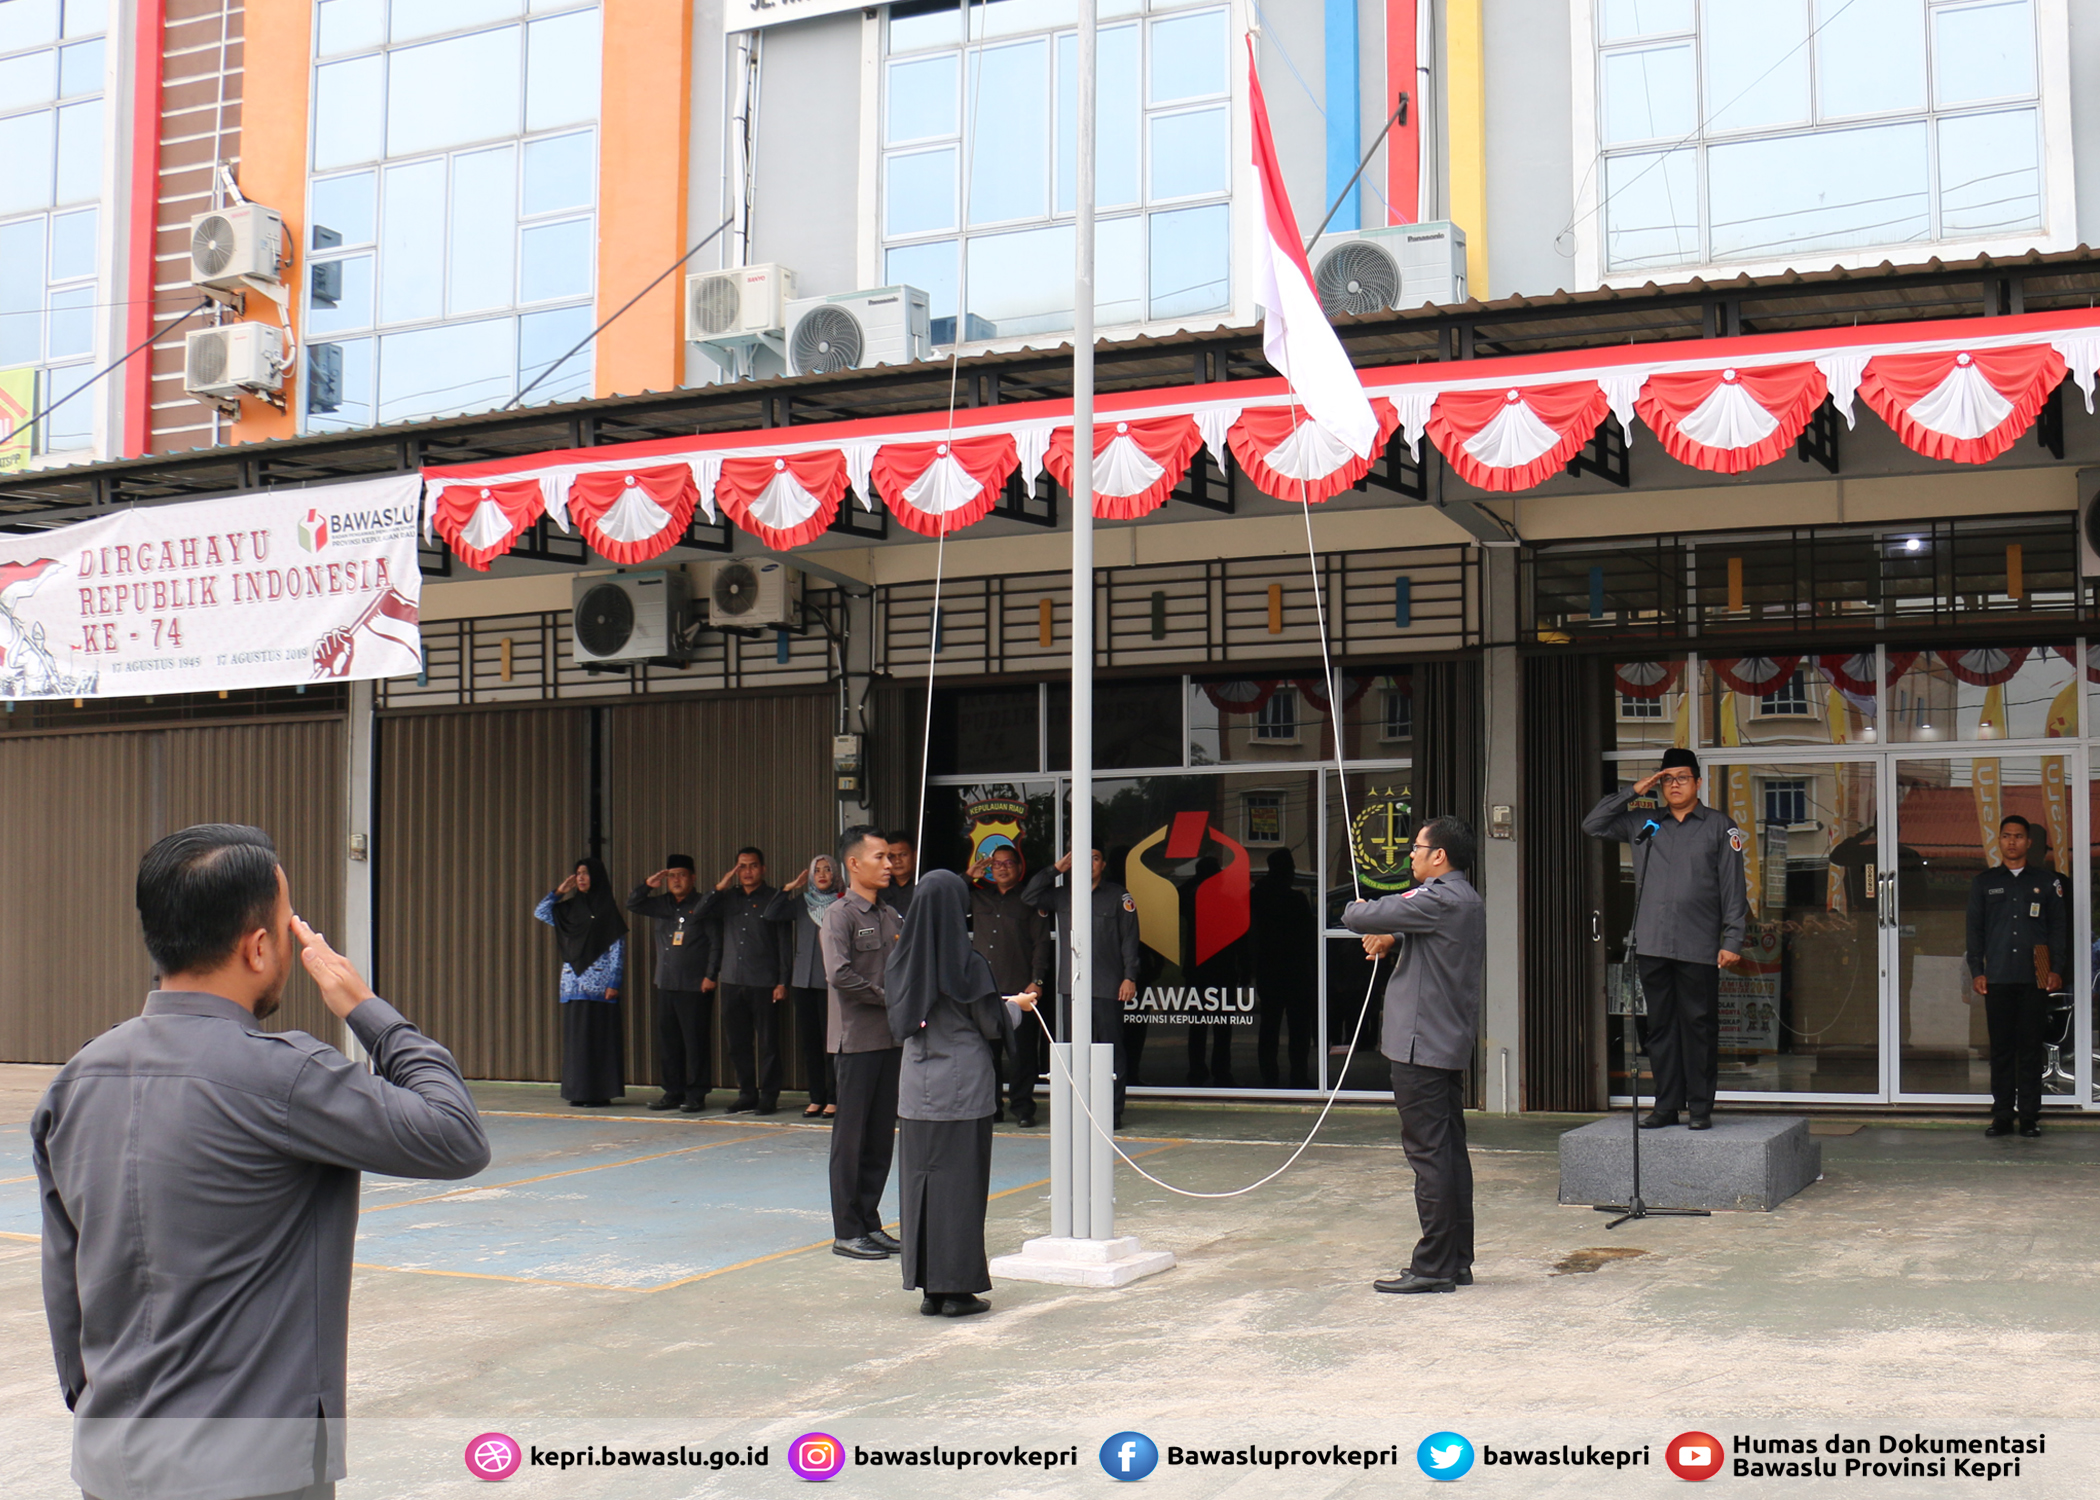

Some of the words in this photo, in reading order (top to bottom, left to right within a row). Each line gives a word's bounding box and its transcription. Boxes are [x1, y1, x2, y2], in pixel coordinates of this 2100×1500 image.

[1407, 232, 1445, 243] Panasonic
[330, 505, 414, 533] BAWASLU
[332, 537, 361, 547] PROVINSI
[77, 529, 270, 578] DIRGAHAYU
[78, 574, 218, 617] REPUBLIK
[231, 556, 393, 604] INDONESIA
[82, 622, 118, 654] KE
[150, 617, 185, 649] 74
[111, 662, 122, 674] 17
[125, 658, 174, 673] AGUSTUS
[178, 656, 201, 670] 1945
[216, 654, 228, 666] 17
[230, 650, 283, 665] AGUSTUS
[285, 648, 309, 661] 2019
[969, 803, 1008, 815] KEPULAUAN
[1008, 803, 1025, 814] RIAU
[1123, 1014, 1167, 1024] PROVINSI
[1169, 1014, 1228, 1025] KEPULAUAN
[1229, 1015, 1254, 1025] RIAU
